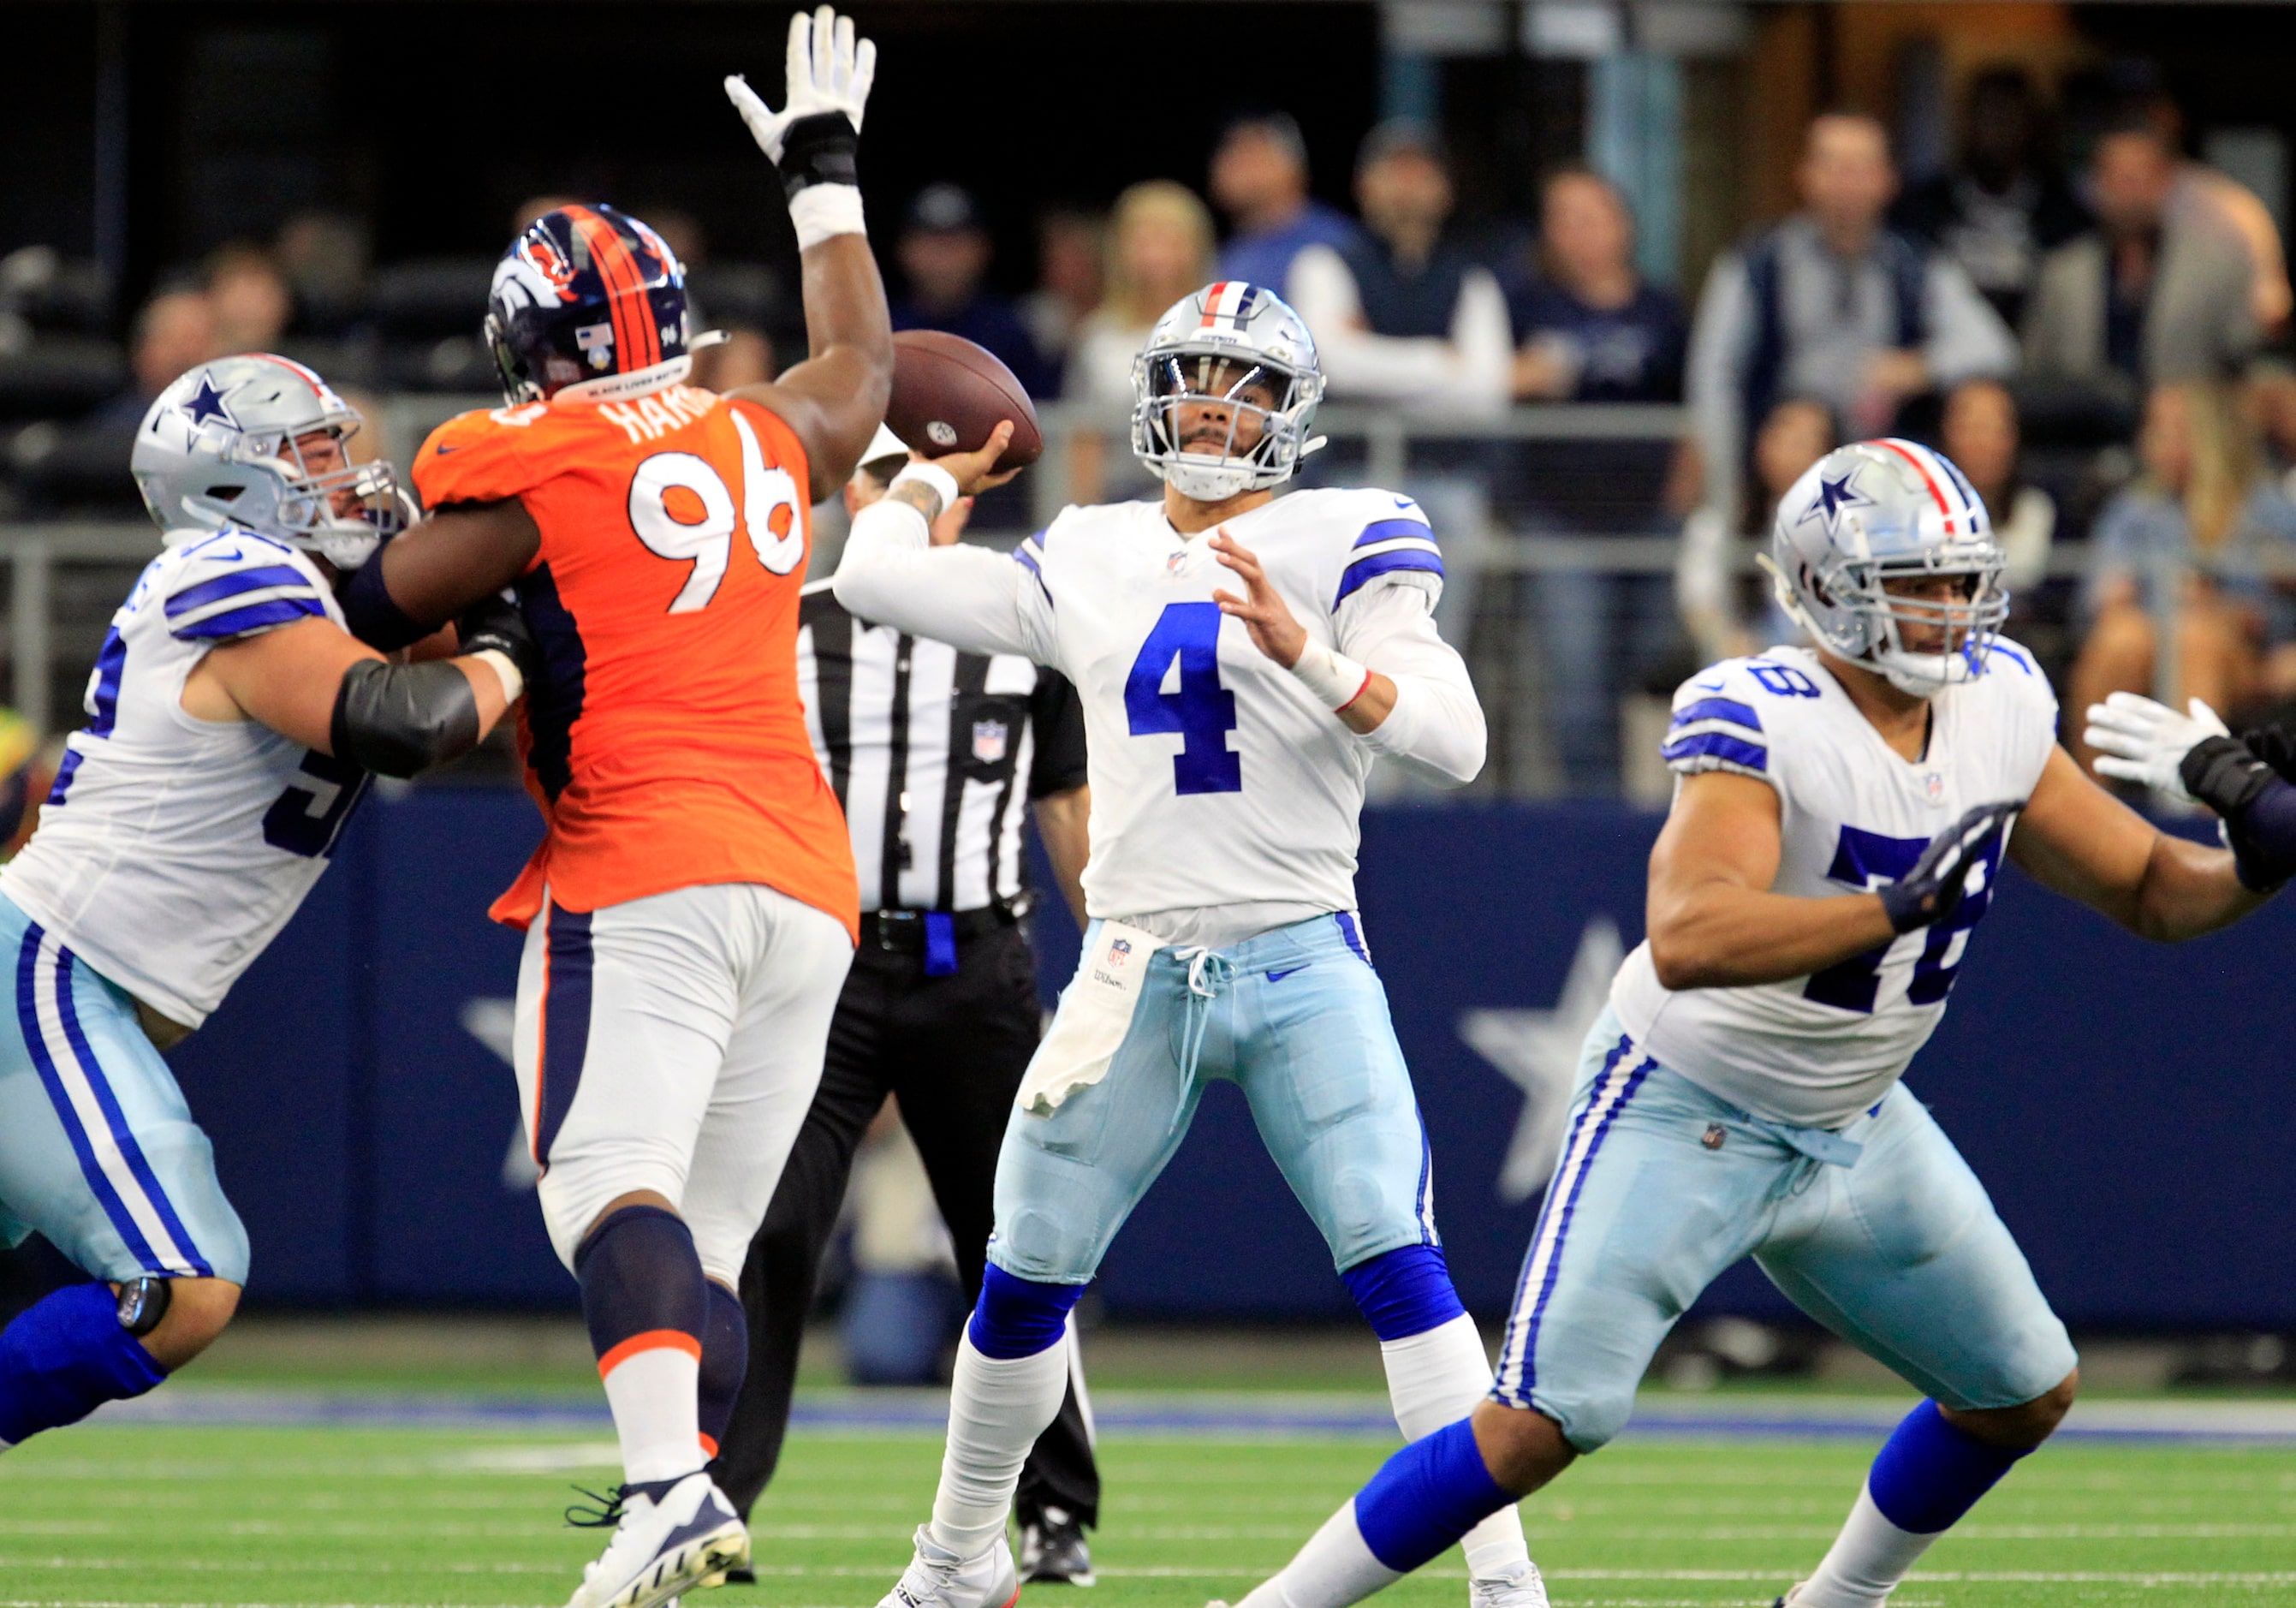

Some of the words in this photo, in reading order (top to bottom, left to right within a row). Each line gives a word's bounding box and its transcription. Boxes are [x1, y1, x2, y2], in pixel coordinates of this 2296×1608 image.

[661, 324, 677, 347] 96
[628, 408, 805, 614] 96
[1124, 602, 1241, 795] 4
